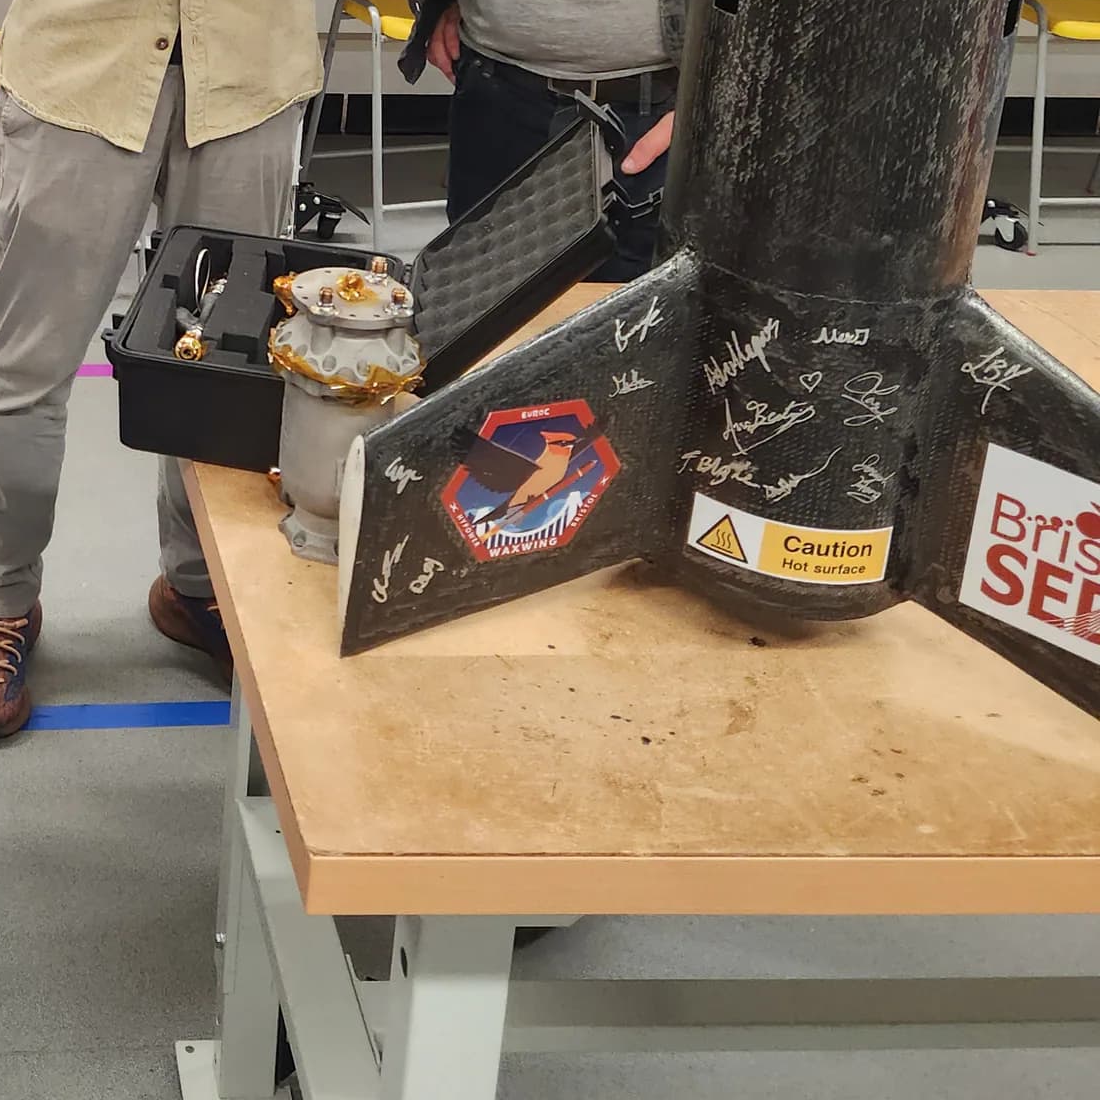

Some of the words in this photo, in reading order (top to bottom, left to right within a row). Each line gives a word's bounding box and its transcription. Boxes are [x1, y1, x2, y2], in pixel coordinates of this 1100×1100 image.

[570, 493, 599, 529] BRISTOL
[488, 536, 558, 558] WAXWING
[783, 535, 873, 558] Caution
[782, 558, 809, 572] Hot
[813, 563, 866, 575] surface
